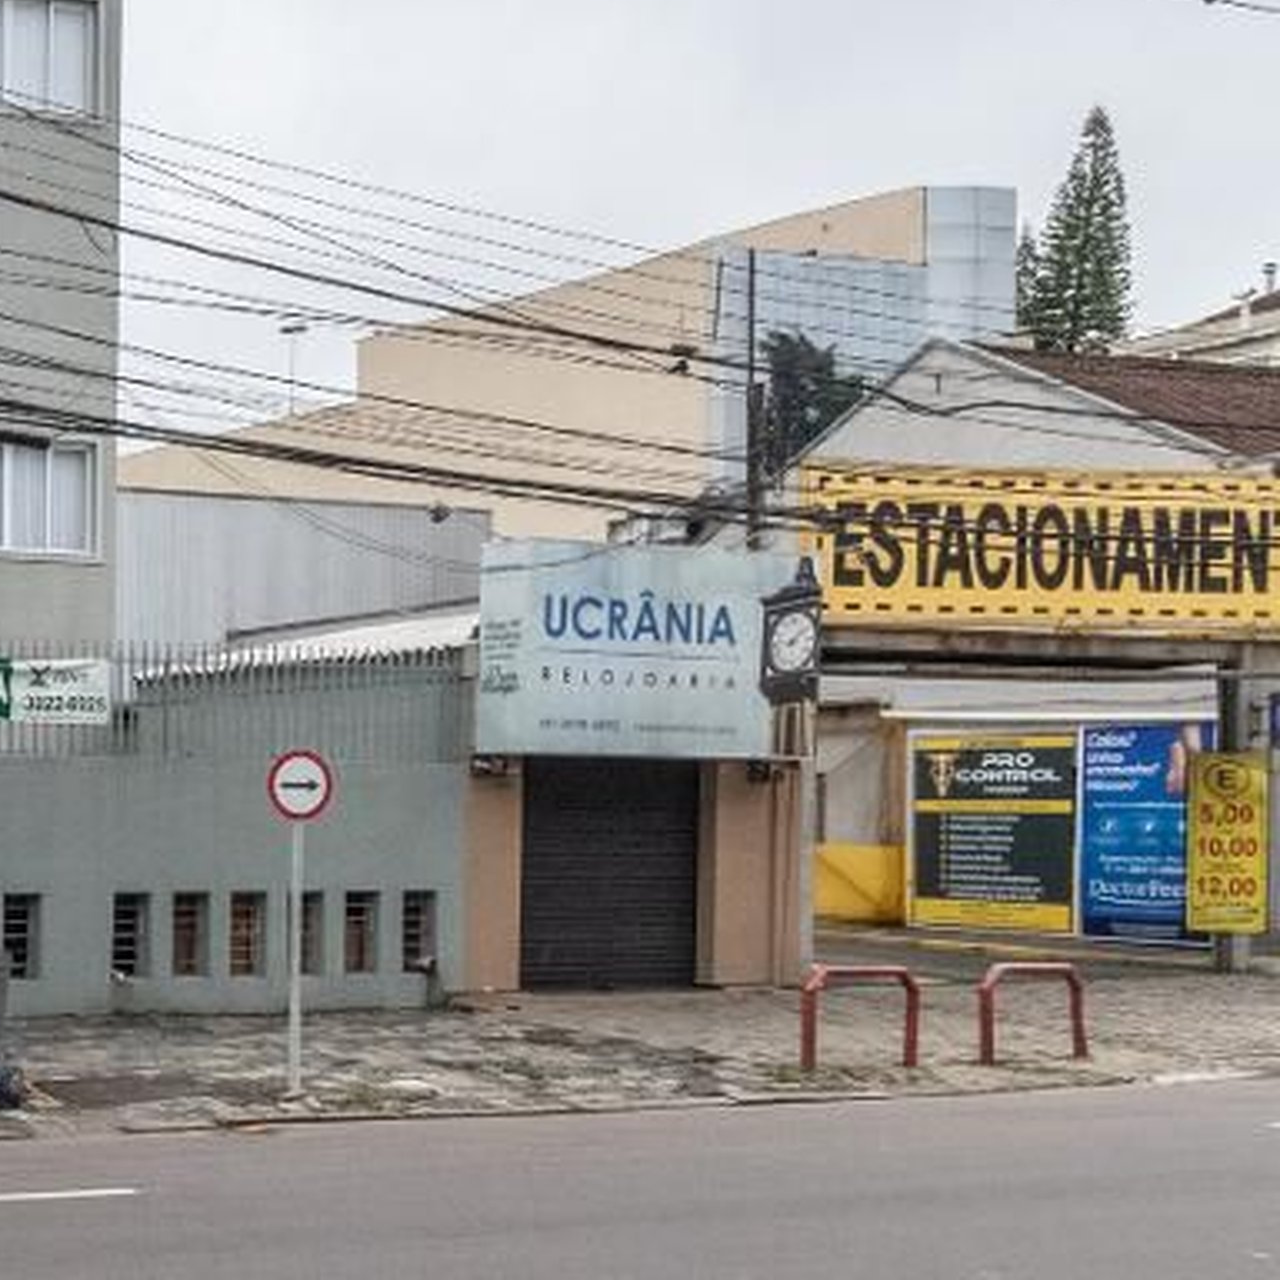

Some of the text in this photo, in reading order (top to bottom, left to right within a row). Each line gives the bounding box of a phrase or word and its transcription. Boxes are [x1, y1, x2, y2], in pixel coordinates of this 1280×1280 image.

[832, 499, 1280, 594] ESTACIONAMEN
[543, 589, 737, 646] UCRÂNIA
[981, 752, 1036, 768] PRO
[955, 768, 1063, 783] CONTROL
[1216, 768, 1238, 791] E
[1198, 836, 1258, 860] 10,00
[1089, 878, 1187, 898] DoctorFee
[1197, 875, 1258, 899] 12,00
